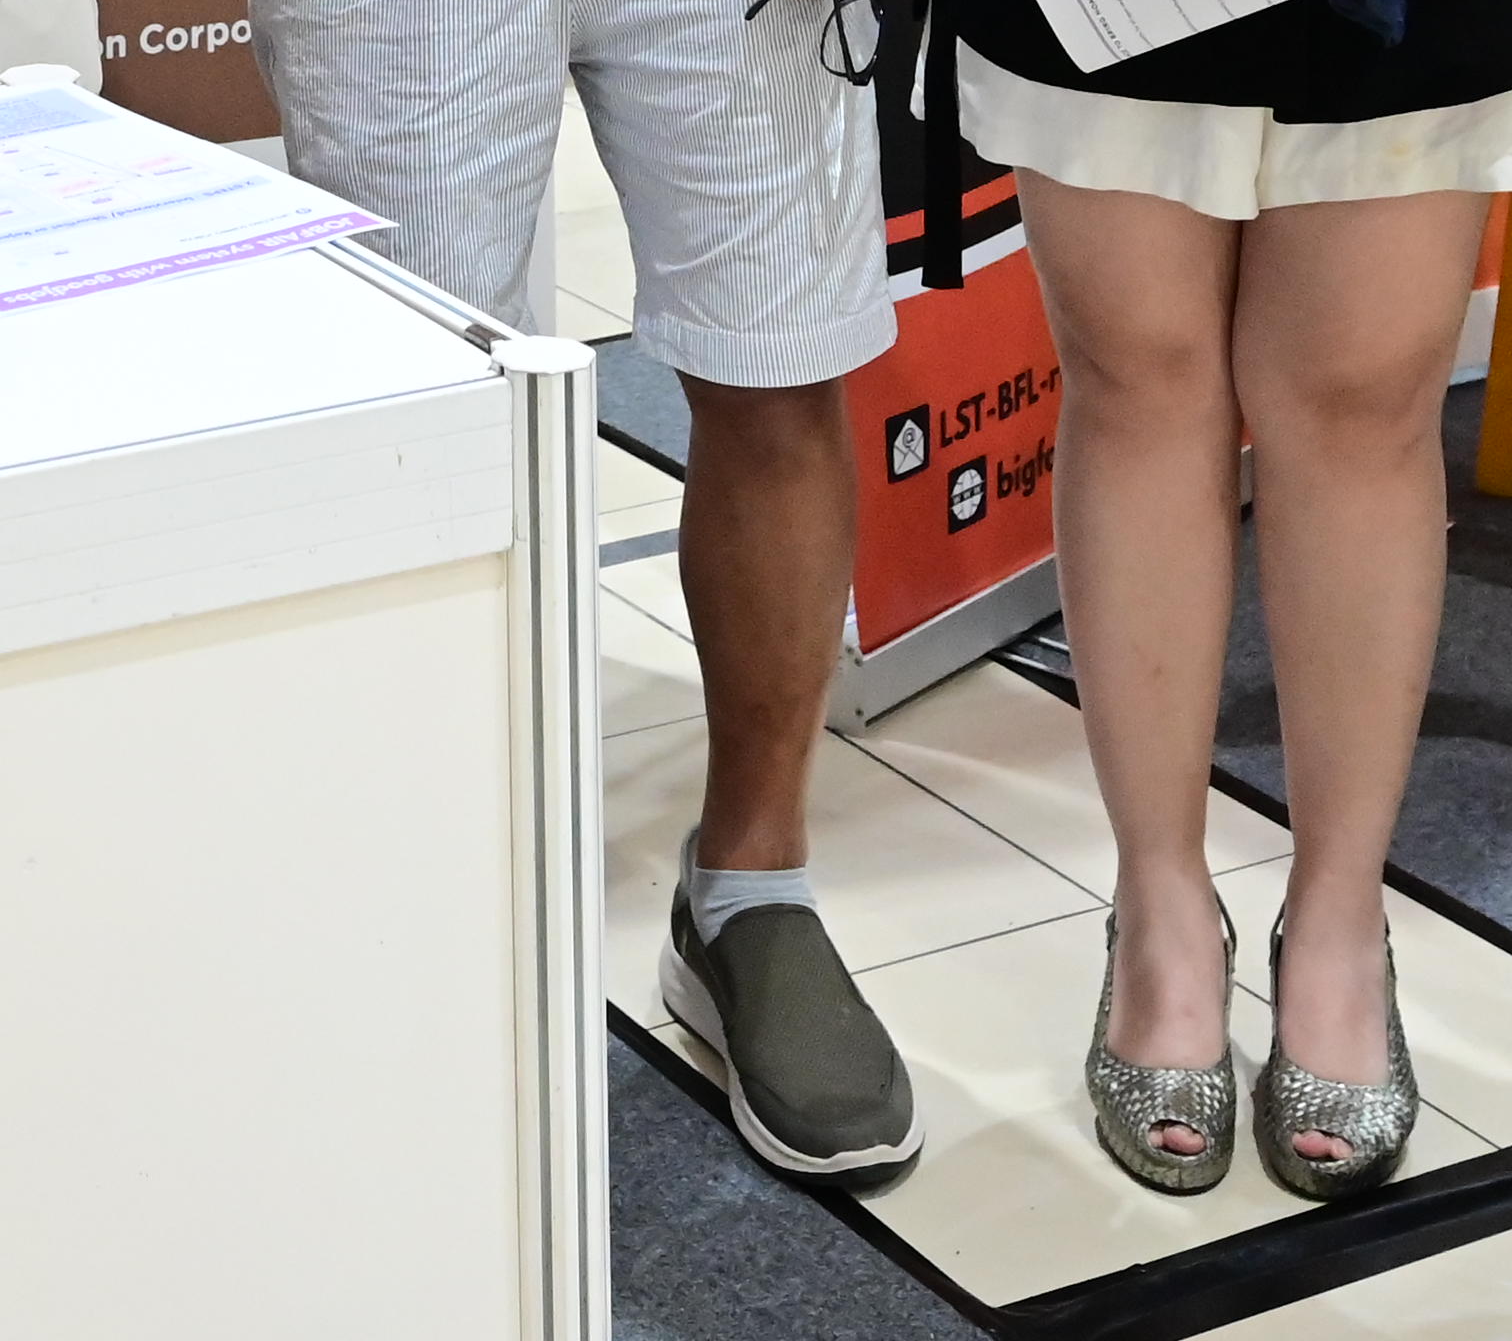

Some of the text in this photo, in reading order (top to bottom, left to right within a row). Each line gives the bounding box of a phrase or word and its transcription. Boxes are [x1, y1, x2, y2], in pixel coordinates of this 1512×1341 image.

[255, 214, 356, 248] JOBFAIR
[117, 260, 173, 280] with
[172, 243, 255, 269] system
[2, 270, 116, 305] goodjobs
